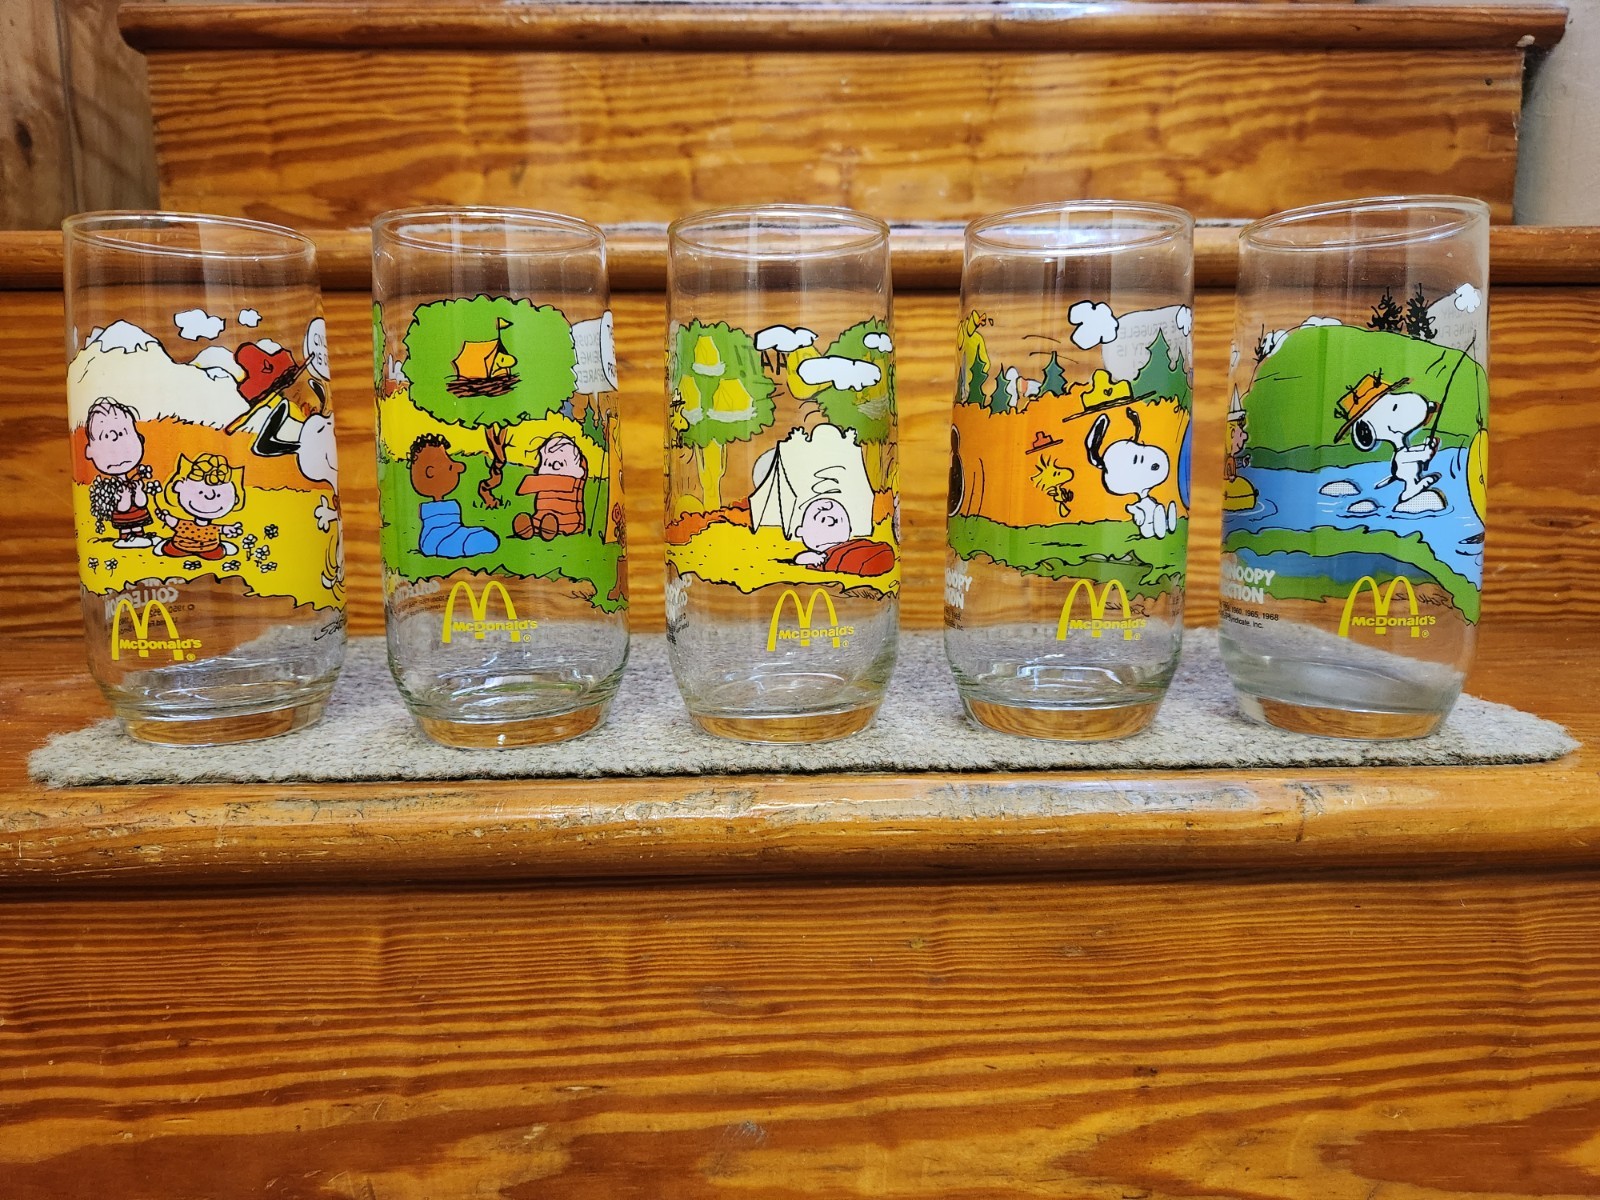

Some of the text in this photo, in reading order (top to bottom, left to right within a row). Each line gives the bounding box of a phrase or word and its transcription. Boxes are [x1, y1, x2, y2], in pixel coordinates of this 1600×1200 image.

[1262, 612, 1279, 621] 1968
[1351, 615, 1436, 627] McDonald's
[452, 619, 538, 632] McDonald's
[1068, 618, 1147, 630] McDonald's
[778, 626, 855, 640] McDonald's
[119, 638, 203, 650] McDonald's
